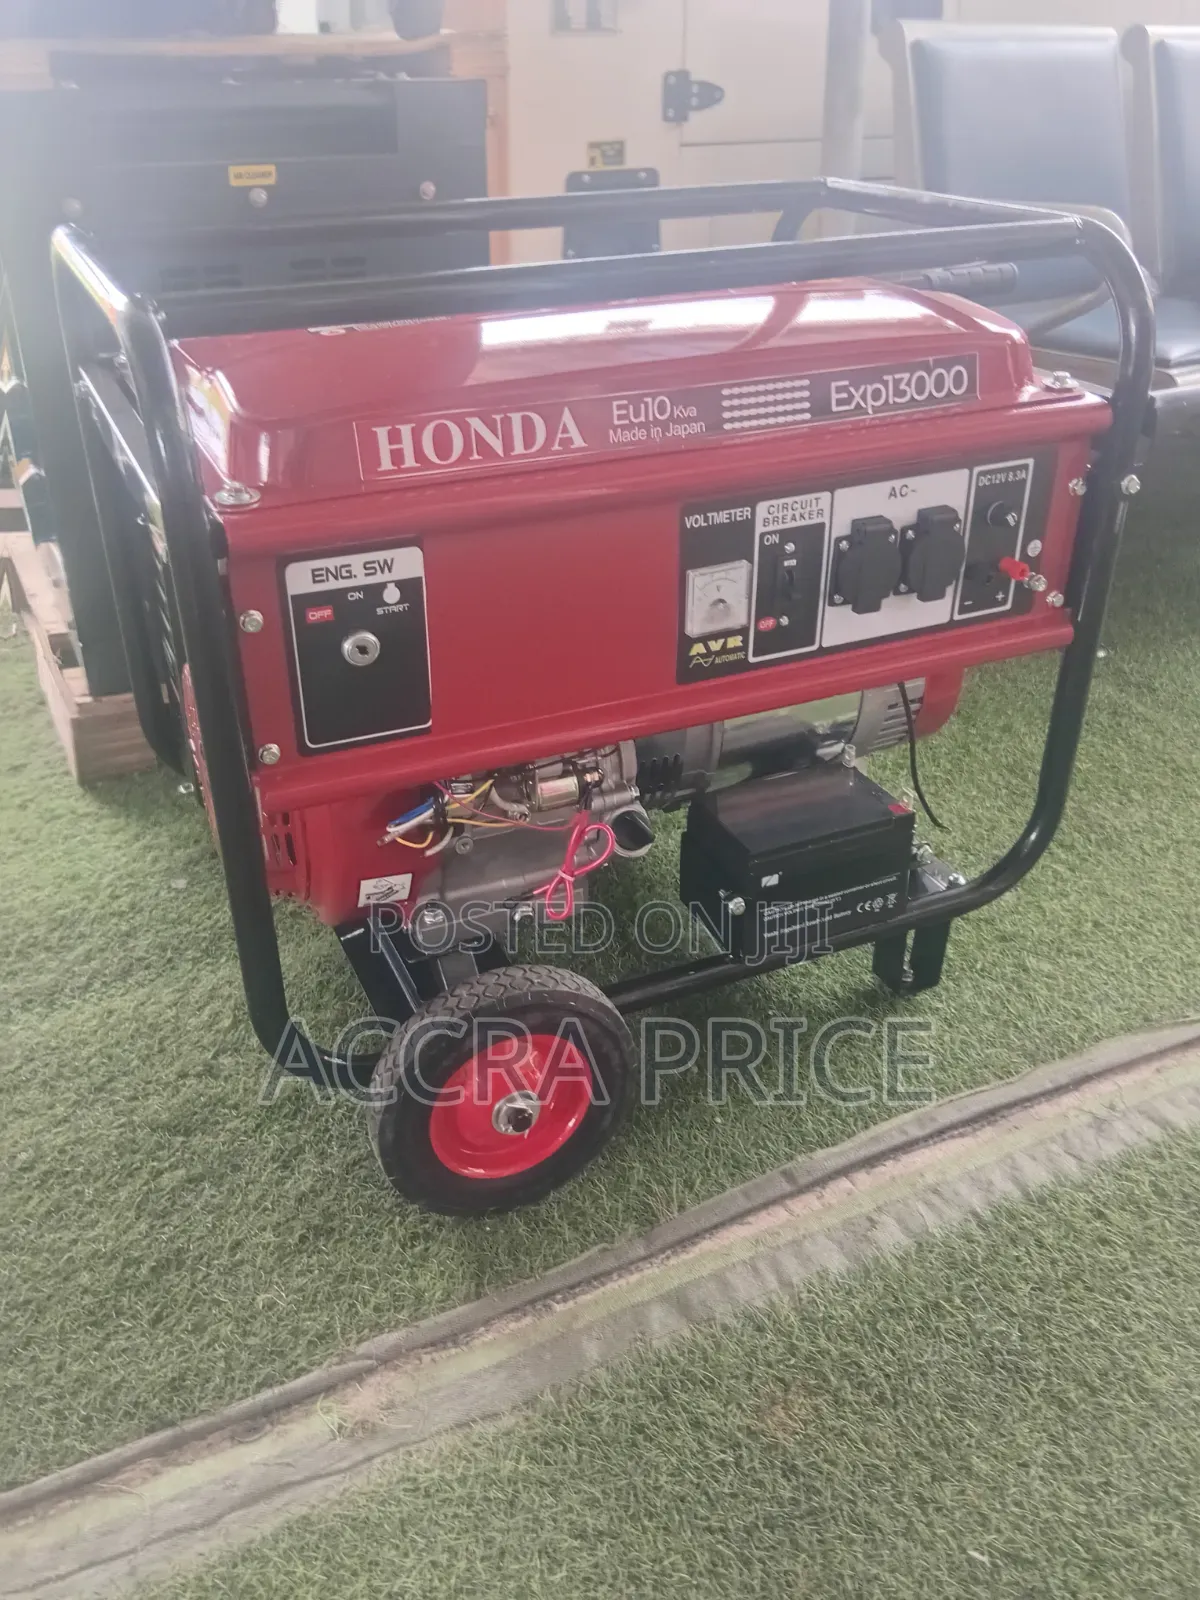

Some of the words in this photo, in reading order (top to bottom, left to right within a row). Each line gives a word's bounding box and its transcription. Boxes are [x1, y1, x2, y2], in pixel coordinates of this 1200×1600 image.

[830, 365, 968, 415] Exp13000
[371, 406, 589, 472] HONDA
[612, 395, 671, 426] Eu10
[673, 404, 698, 419] Kva
[608, 427, 648, 444] Made
[649, 426, 663, 442] in
[664, 420, 707, 439] Japan
[977, 472, 1007, 487] DC12V
[1007, 468, 1028, 482] 8.3A
[767, 497, 822, 516] CIRCUIT
[684, 506, 752, 529] VOLTMETER
[762, 508, 825, 528] BREAKER
[763, 533, 780, 546] ON
[310, 563, 358, 585] ENG.
[363, 557, 395, 577] SW
[347, 590, 364, 601] ON
[308, 608, 333, 621] OFF
[375, 602, 411, 616] START
[688, 635, 744, 657] AVR
[714, 651, 747, 665] AUTOMATIC
